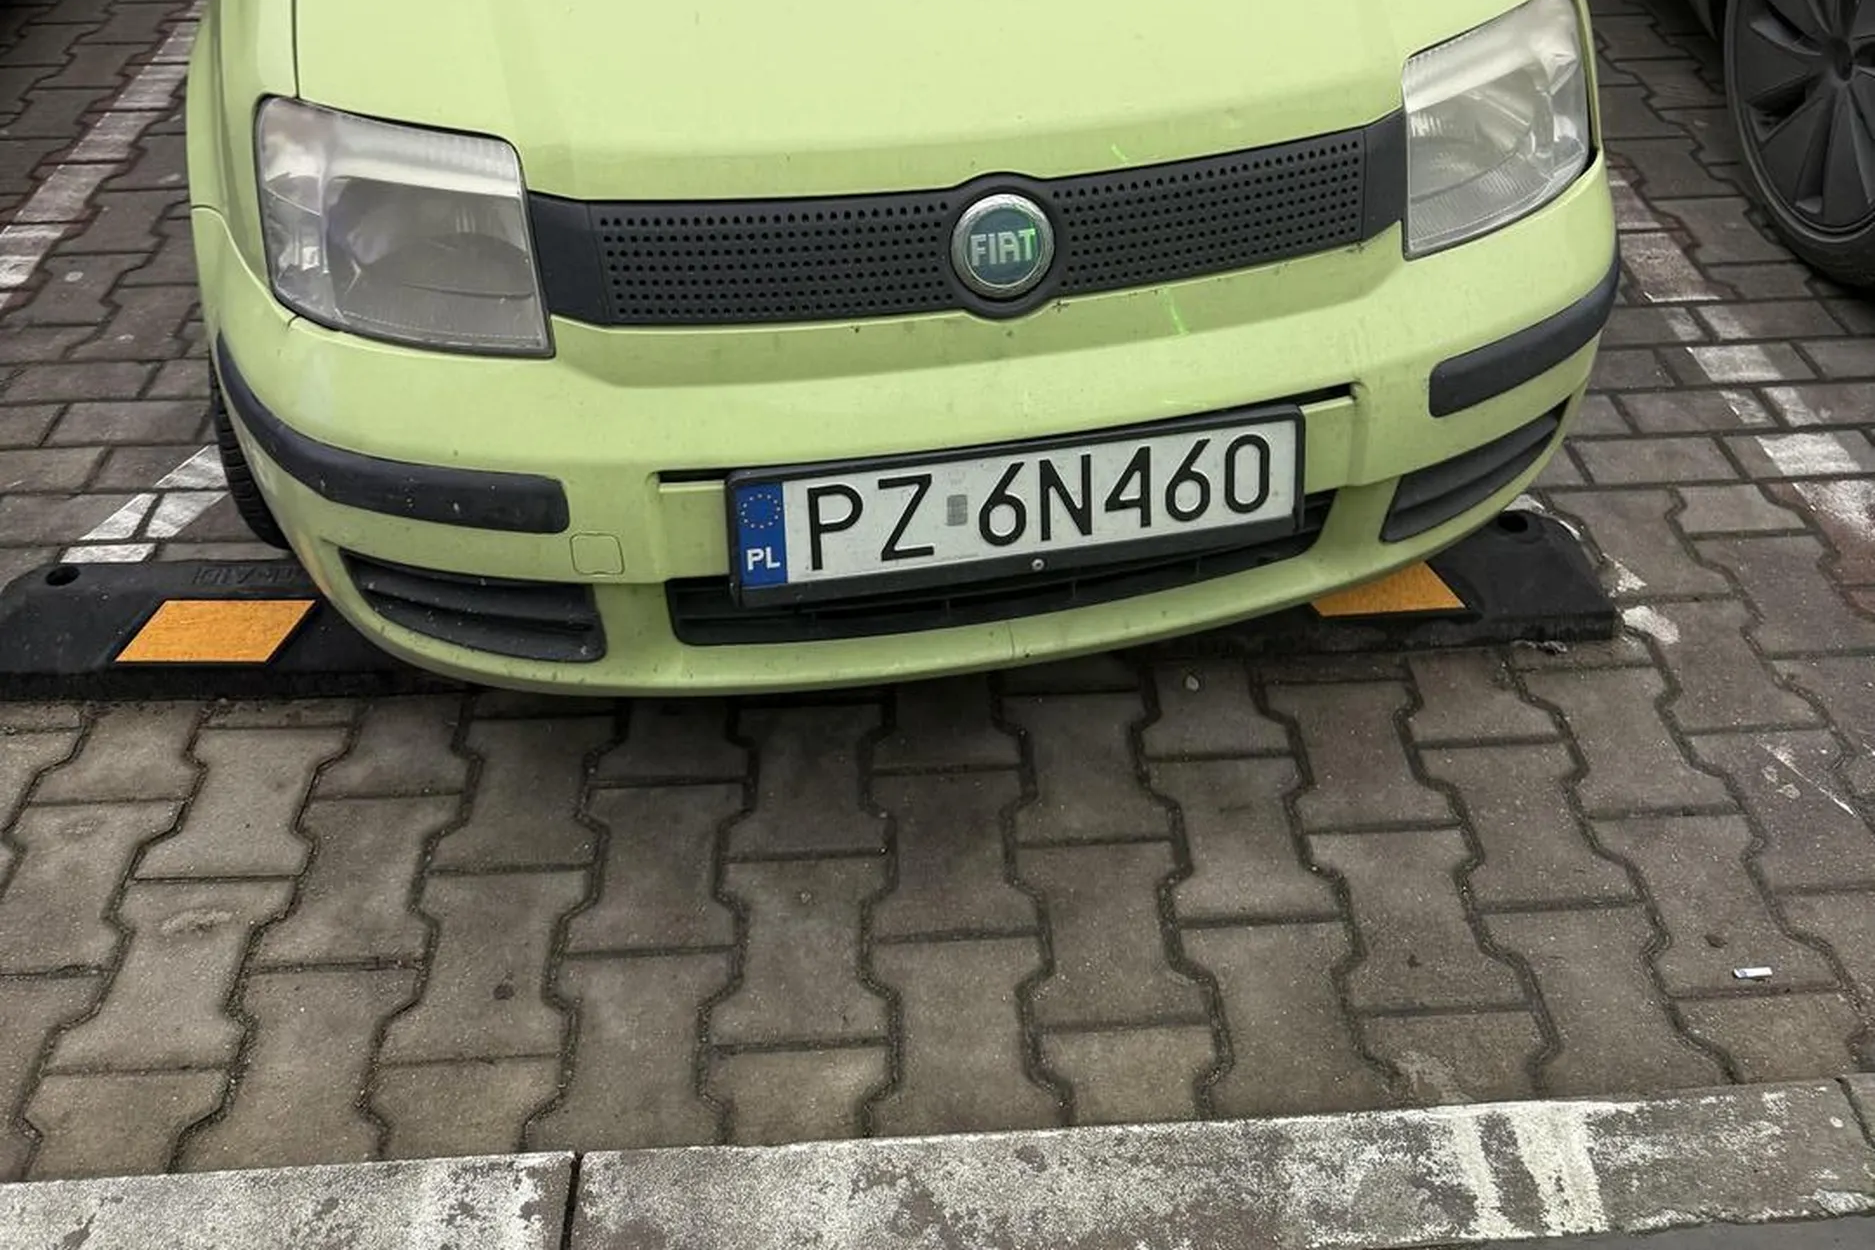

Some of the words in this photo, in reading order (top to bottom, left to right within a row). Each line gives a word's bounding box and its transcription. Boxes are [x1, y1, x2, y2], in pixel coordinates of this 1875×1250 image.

[970, 228, 1036, 267] FIAT
[806, 473, 935, 571] PZ
[977, 433, 1271, 547] 6N460
[746, 546, 781, 571] PL
